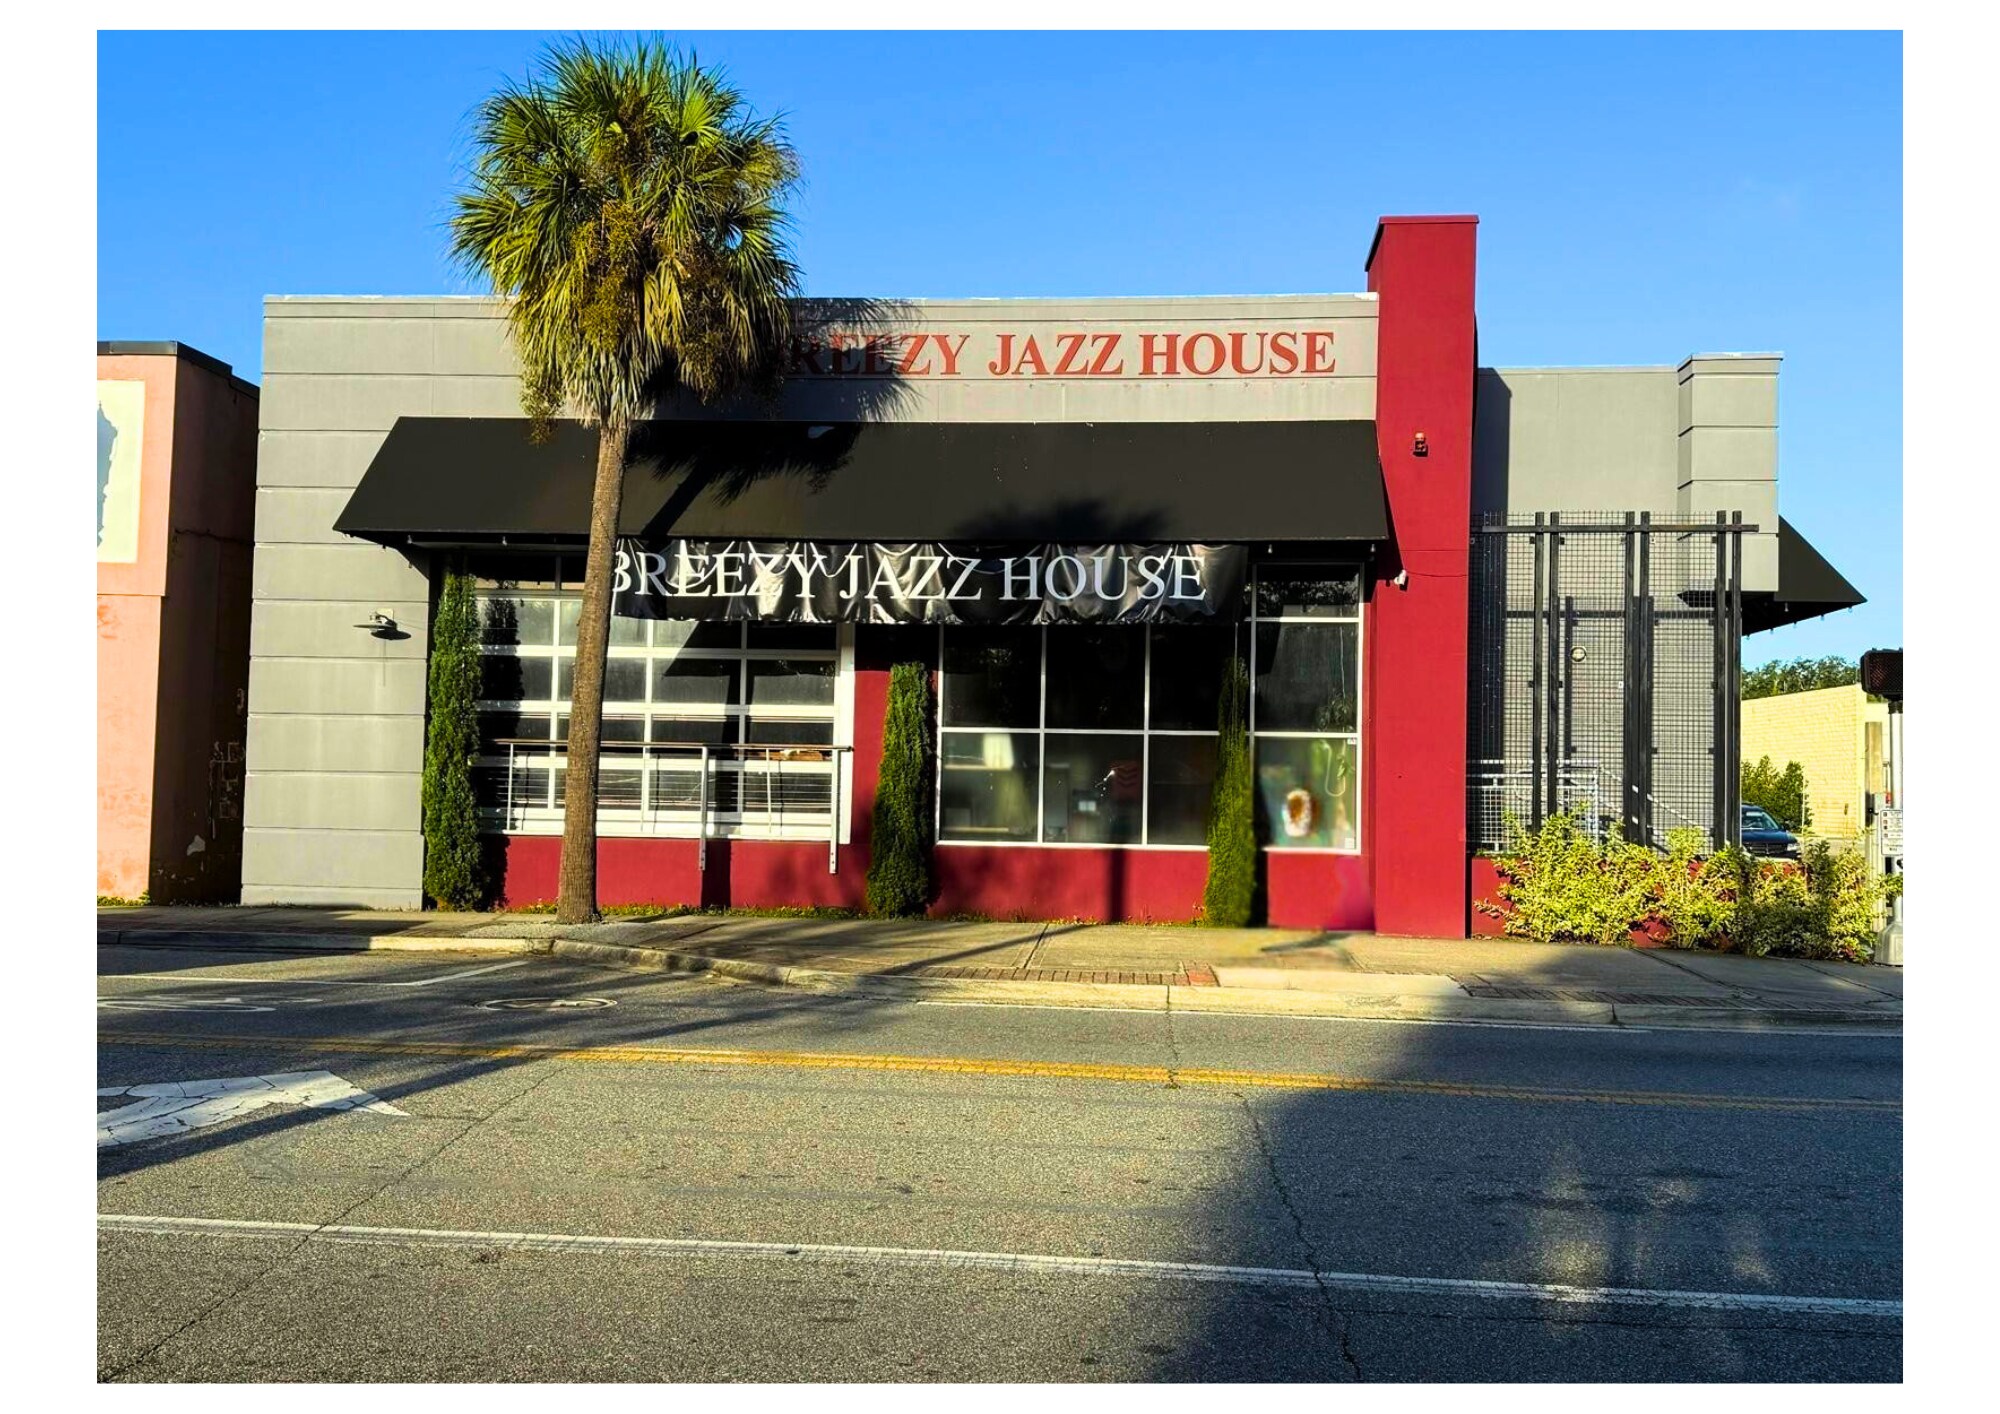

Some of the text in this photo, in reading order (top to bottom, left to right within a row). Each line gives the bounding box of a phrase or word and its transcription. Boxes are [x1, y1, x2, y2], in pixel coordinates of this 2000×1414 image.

[782, 331, 1336, 376] REEZY JAZZ HOUSE
[611, 550, 1207, 601] BREEZY JAZZ HOUSE
